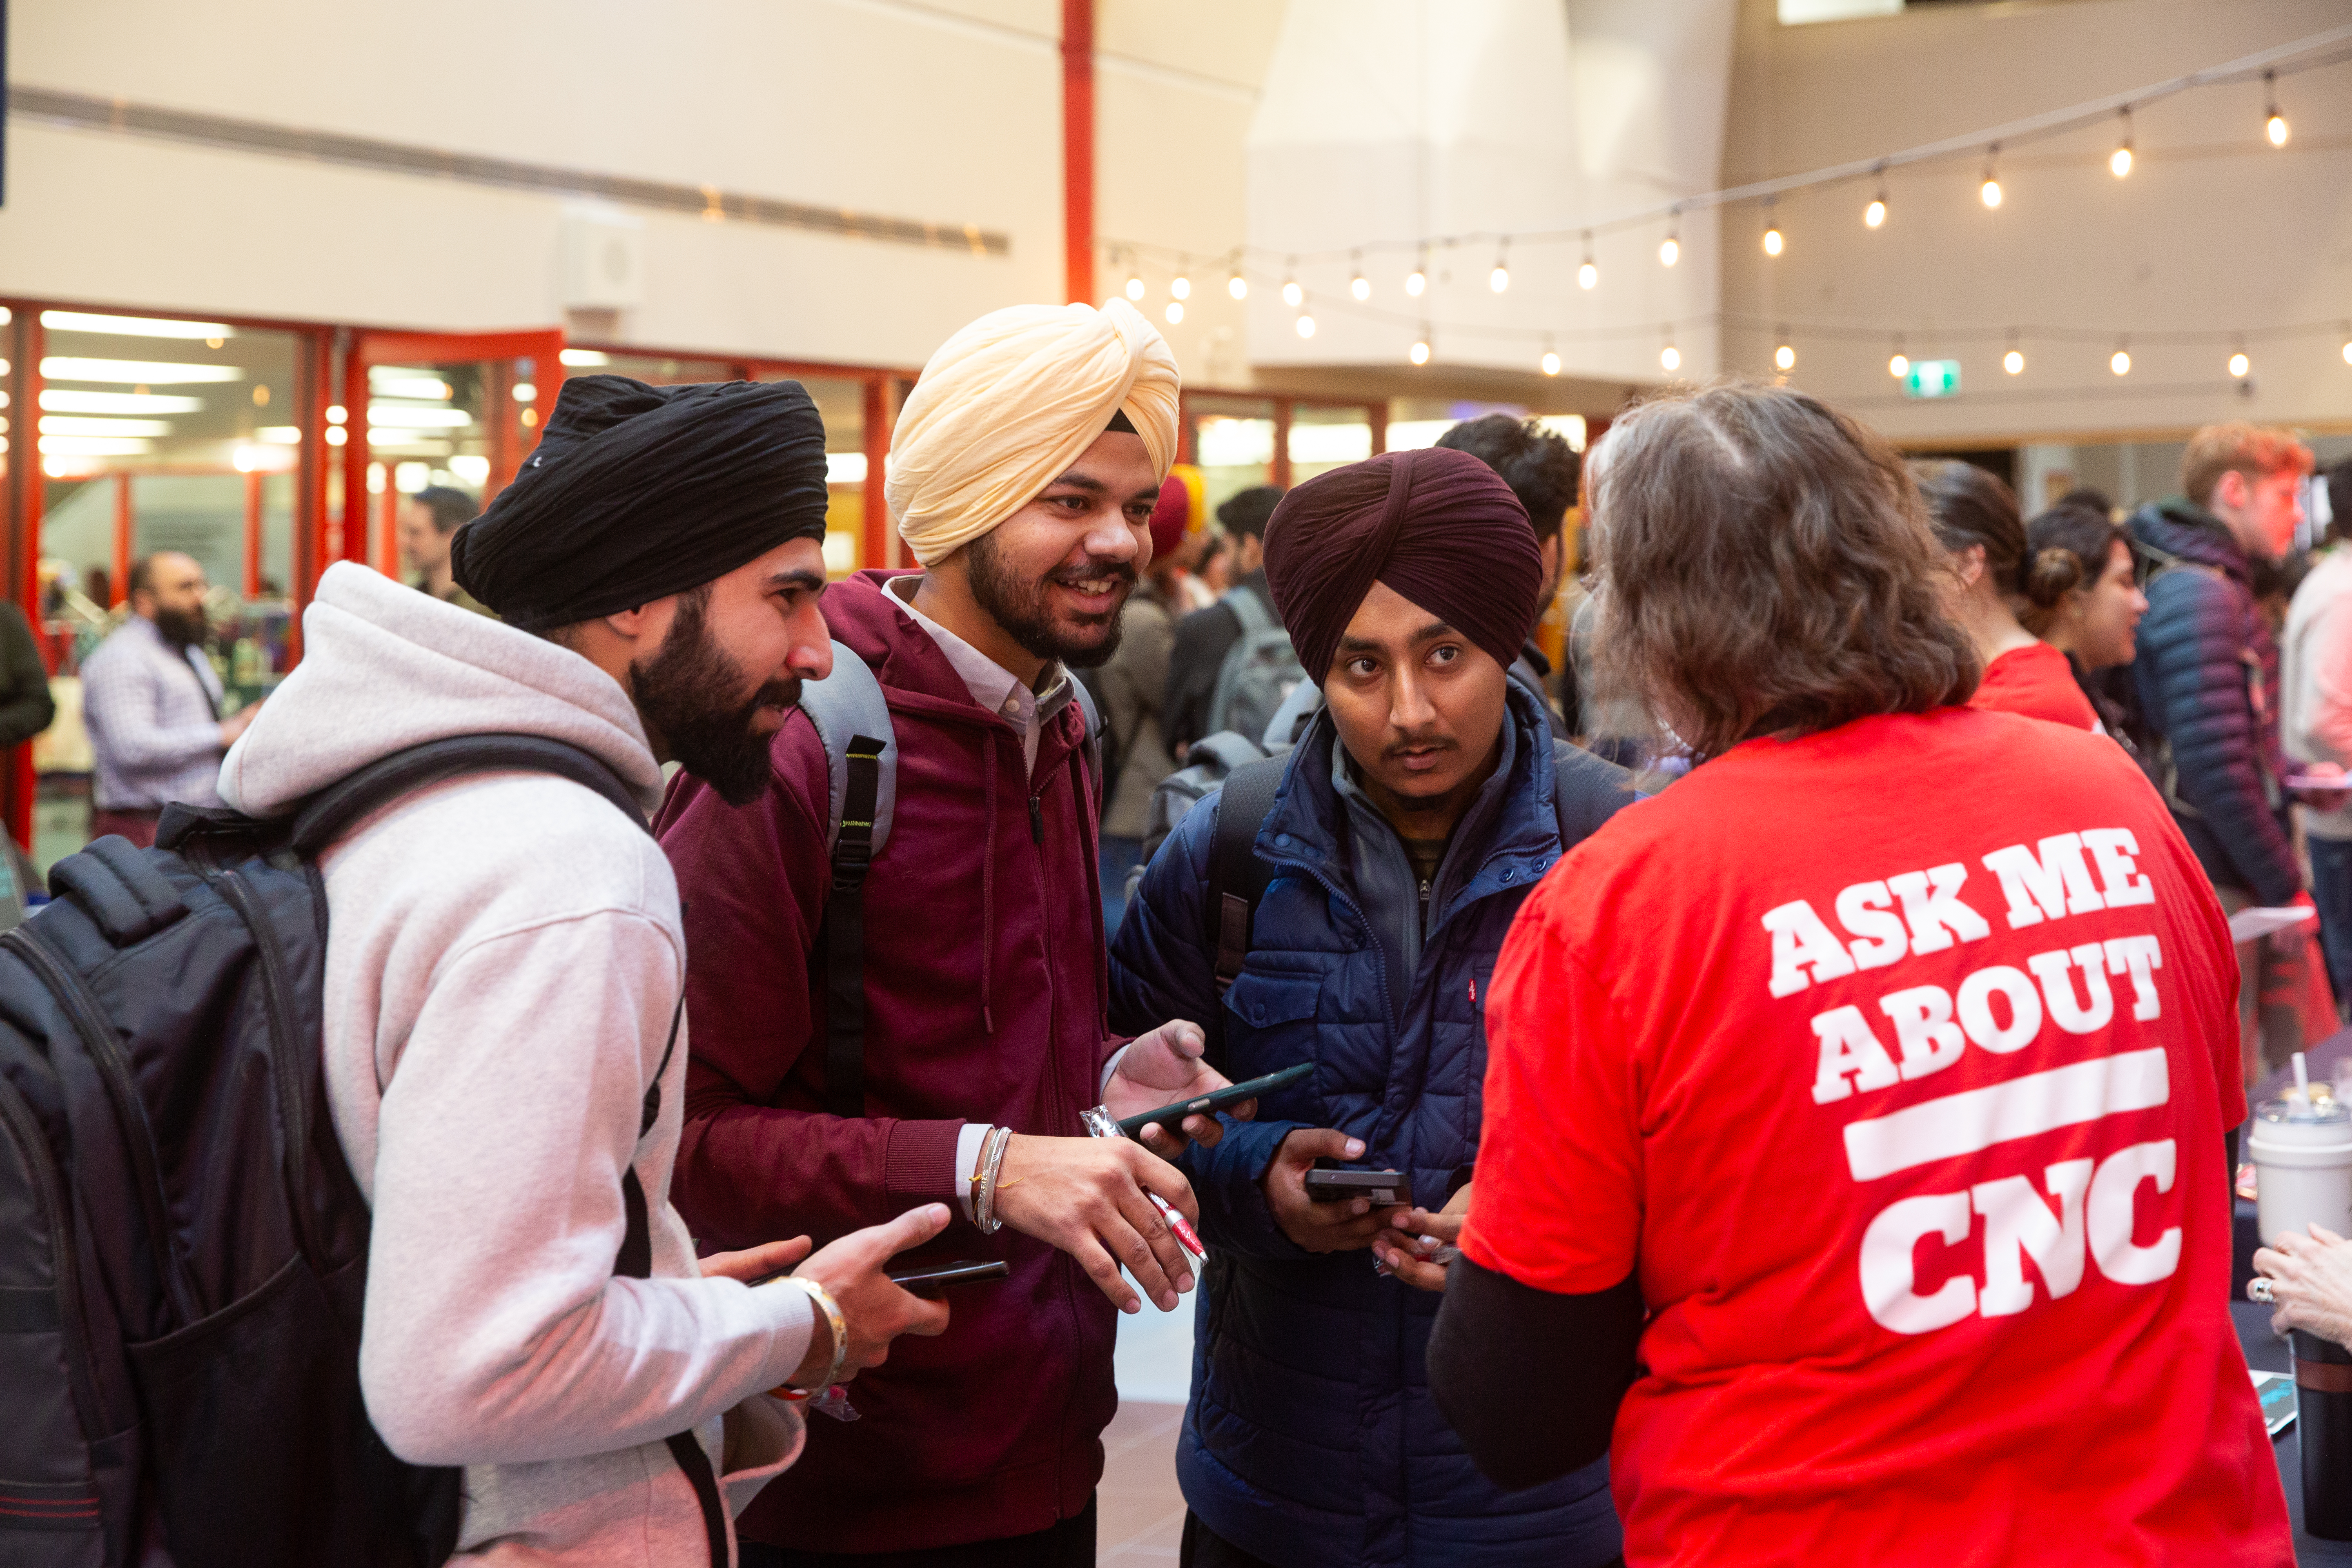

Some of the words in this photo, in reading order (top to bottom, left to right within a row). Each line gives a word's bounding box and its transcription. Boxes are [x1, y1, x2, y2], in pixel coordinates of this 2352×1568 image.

[1761, 862, 1991, 998] ASK
[1980, 826, 2156, 930] ME
[1810, 934, 2163, 1104] ABOUT
[1859, 1138, 2182, 1334] CNC
